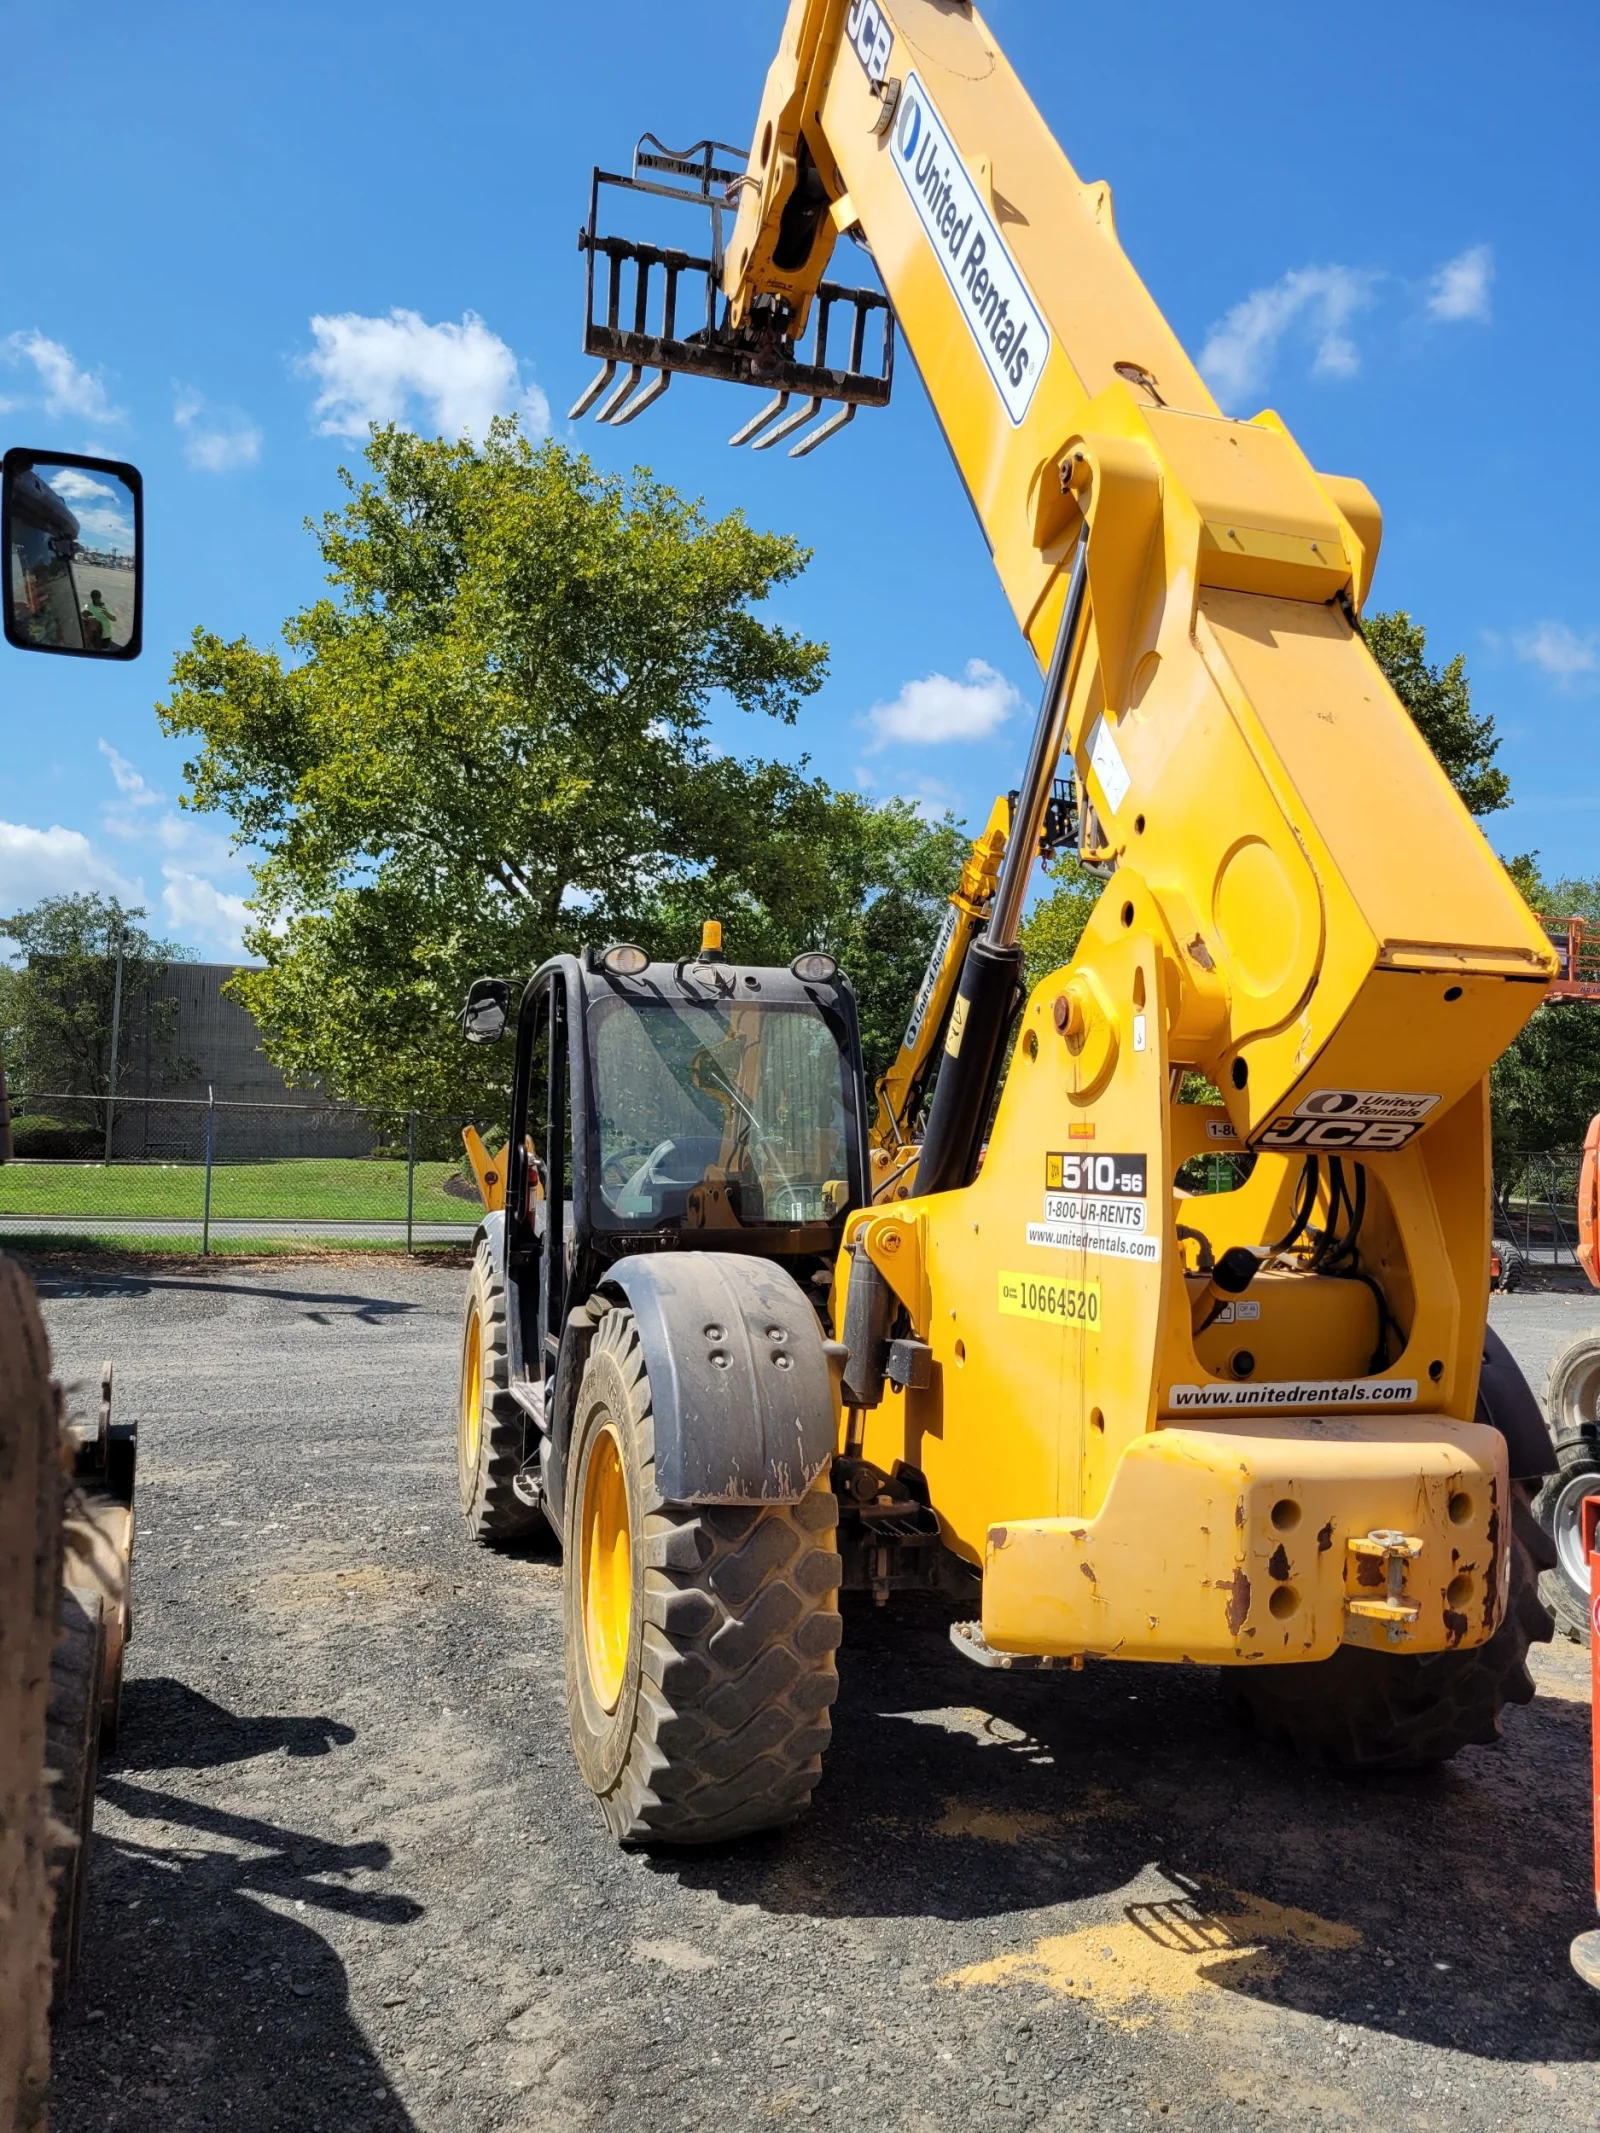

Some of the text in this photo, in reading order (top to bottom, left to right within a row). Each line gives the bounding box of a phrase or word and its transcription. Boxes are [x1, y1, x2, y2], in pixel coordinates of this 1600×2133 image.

[847, 0, 891, 81] JCB
[915, 130, 1029, 388] United Rentals
[914, 914, 956, 1024] United Rentals
[1352, 1105, 1422, 1118] Rentals
[1362, 1095, 1428, 1108] United
[1261, 1119, 1416, 1146] JCB
[1047, 1200, 1142, 1226] 1-800-UR-RENTS
[1029, 1229, 1156, 1258] www.unitedrentals.com
[1020, 1282, 1098, 1322] 10664520
[1176, 1384, 1412, 1405] www.unitedrentals.com
